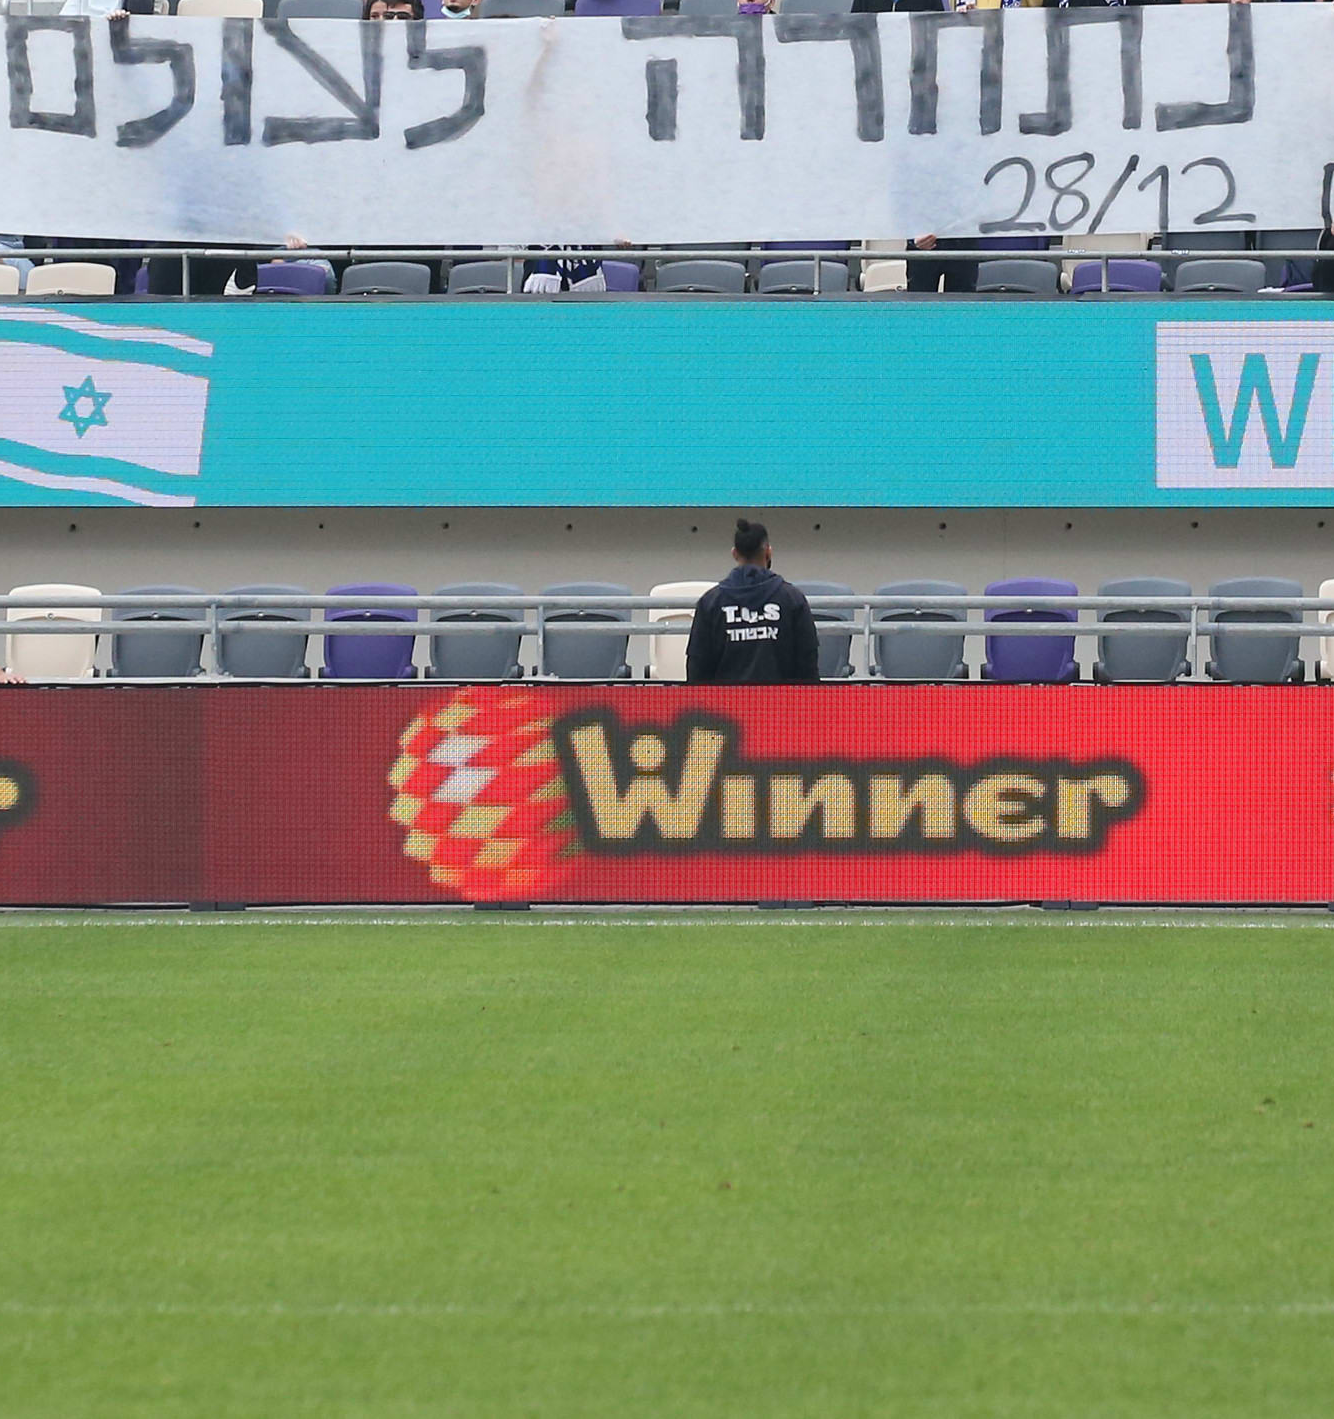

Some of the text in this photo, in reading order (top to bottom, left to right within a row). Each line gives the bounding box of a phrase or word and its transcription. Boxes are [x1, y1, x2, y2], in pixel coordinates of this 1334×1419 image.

[621, 1, 1256, 143] נתחרה
[979, 152, 1257, 234] 28/12
[569, 722, 1132, 844] Winner
